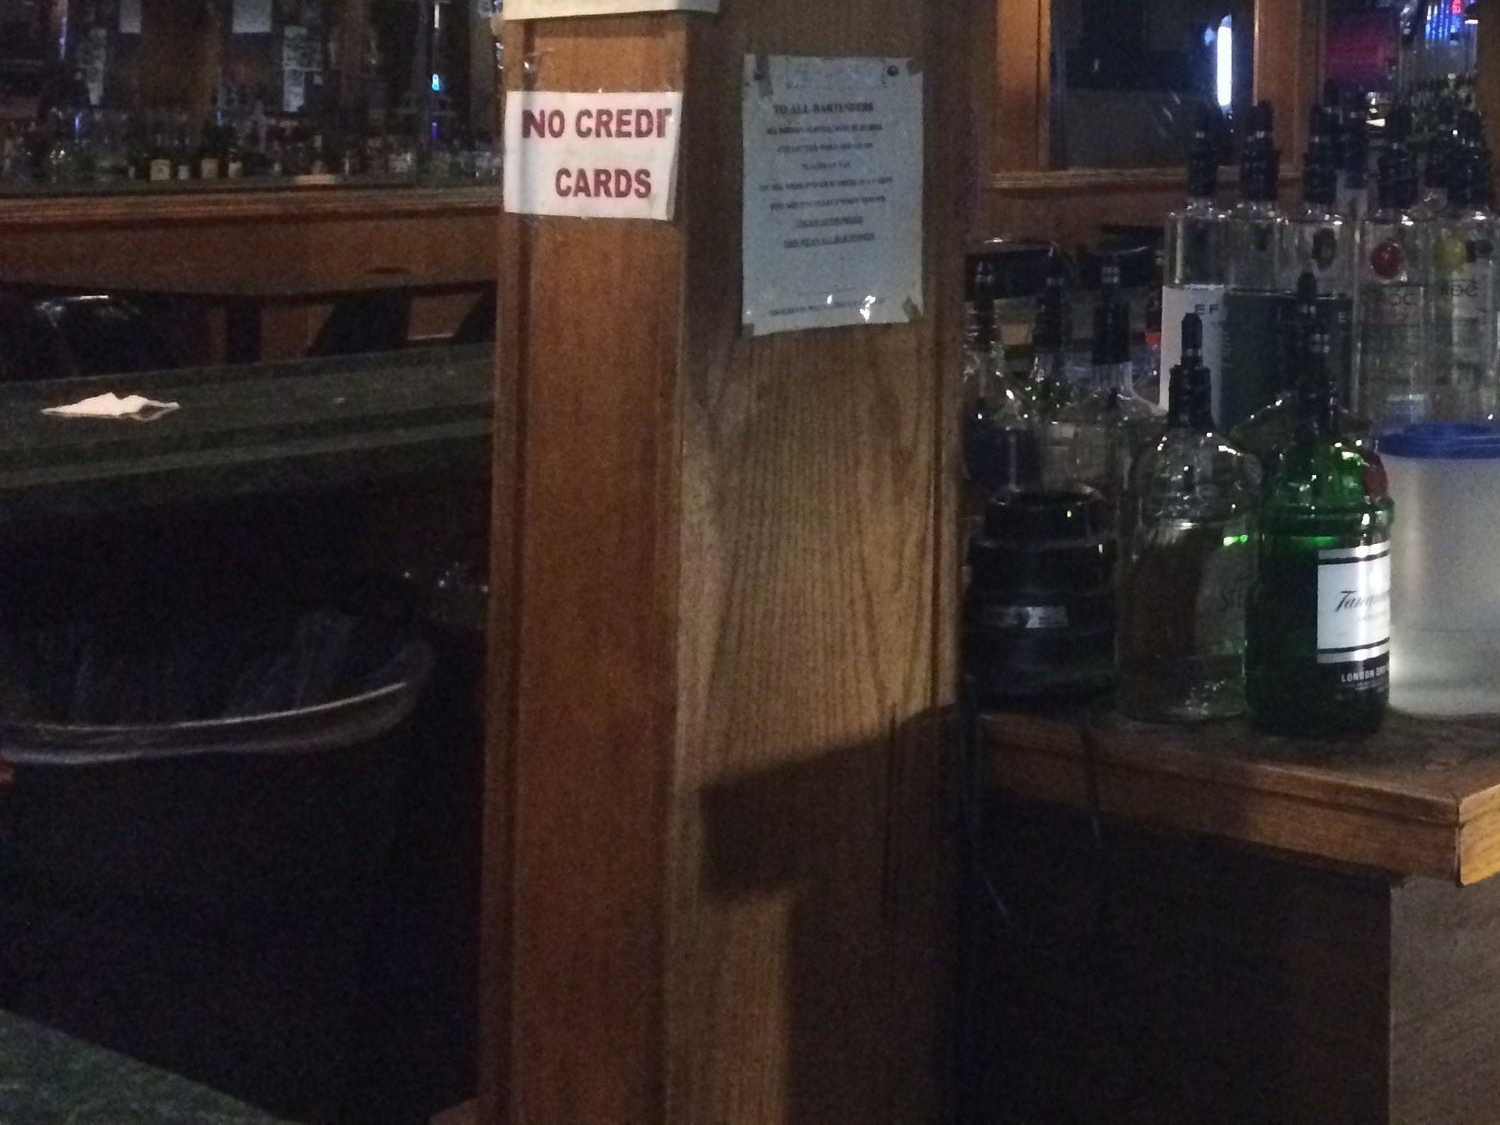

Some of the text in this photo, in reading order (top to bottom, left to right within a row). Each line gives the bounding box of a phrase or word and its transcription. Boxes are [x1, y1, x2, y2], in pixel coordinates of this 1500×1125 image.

[522, 108, 672, 138] NO CREDIT
[555, 168, 651, 199] CARDS
